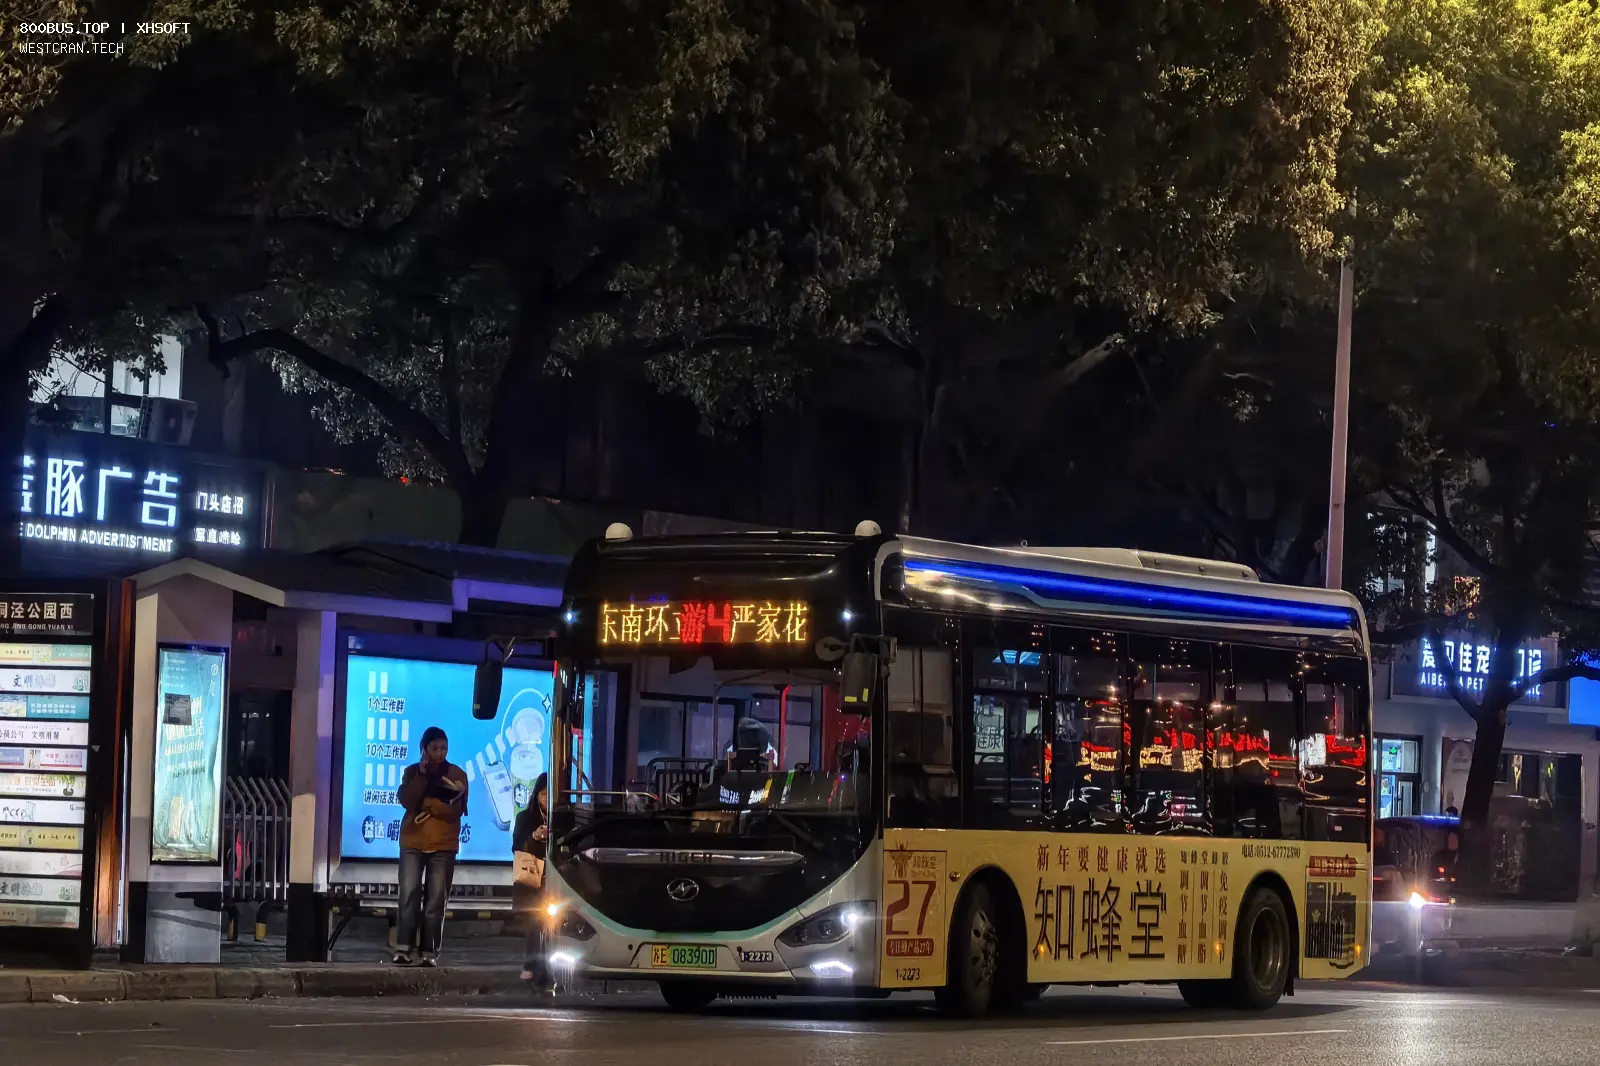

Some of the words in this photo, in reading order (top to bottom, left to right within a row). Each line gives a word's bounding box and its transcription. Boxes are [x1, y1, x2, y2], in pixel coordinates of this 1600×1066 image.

[195, 491, 243, 515] 门头店招
[26, 522, 76, 542] DOLPHIN
[731, 602, 808, 643] 严家花
[1466, 676, 1484, 691] PET
[368, 697, 405, 714] 1个工作群
[366, 743, 408, 759] 10个工作群
[364, 819, 384, 839] 益达
[1036, 844, 1167, 874] 新年要健康就选
[885, 880, 937, 936] 27
[1177, 869, 1189, 965] 调节血糖
[1197, 870, 1209, 965] 调节血脂
[1032, 876, 1167, 964] 知蜂堂
[672, 948, 716, 965] 08390D
[896, 967, 921, 981] 1-2273
